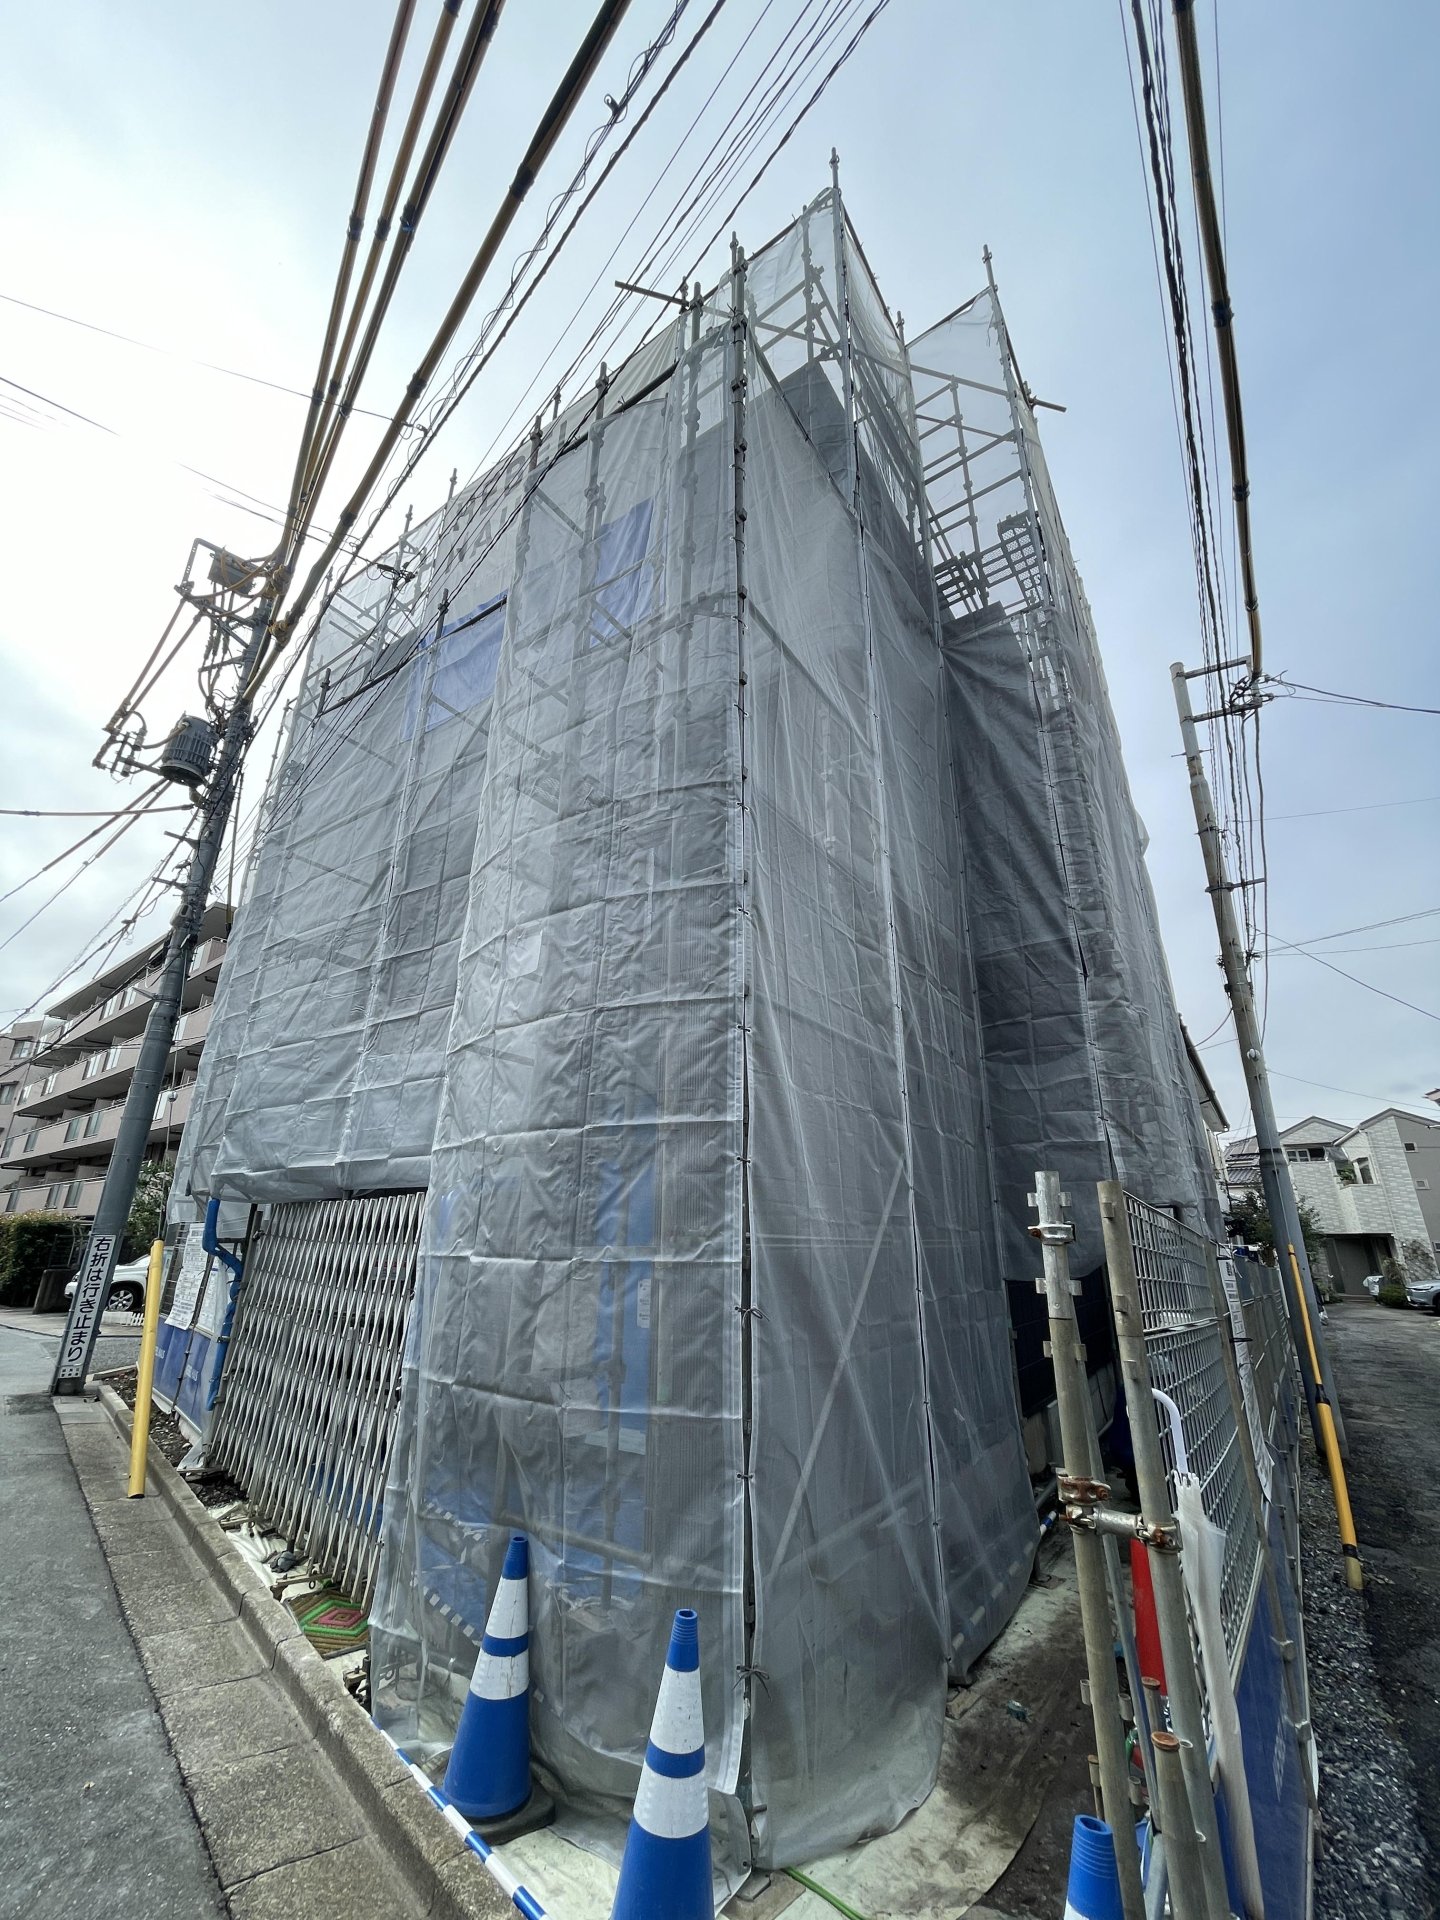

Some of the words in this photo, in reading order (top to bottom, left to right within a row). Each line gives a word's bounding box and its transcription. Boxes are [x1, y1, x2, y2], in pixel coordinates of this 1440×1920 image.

[67, 1236, 113, 1363] 右折は行き止まり
